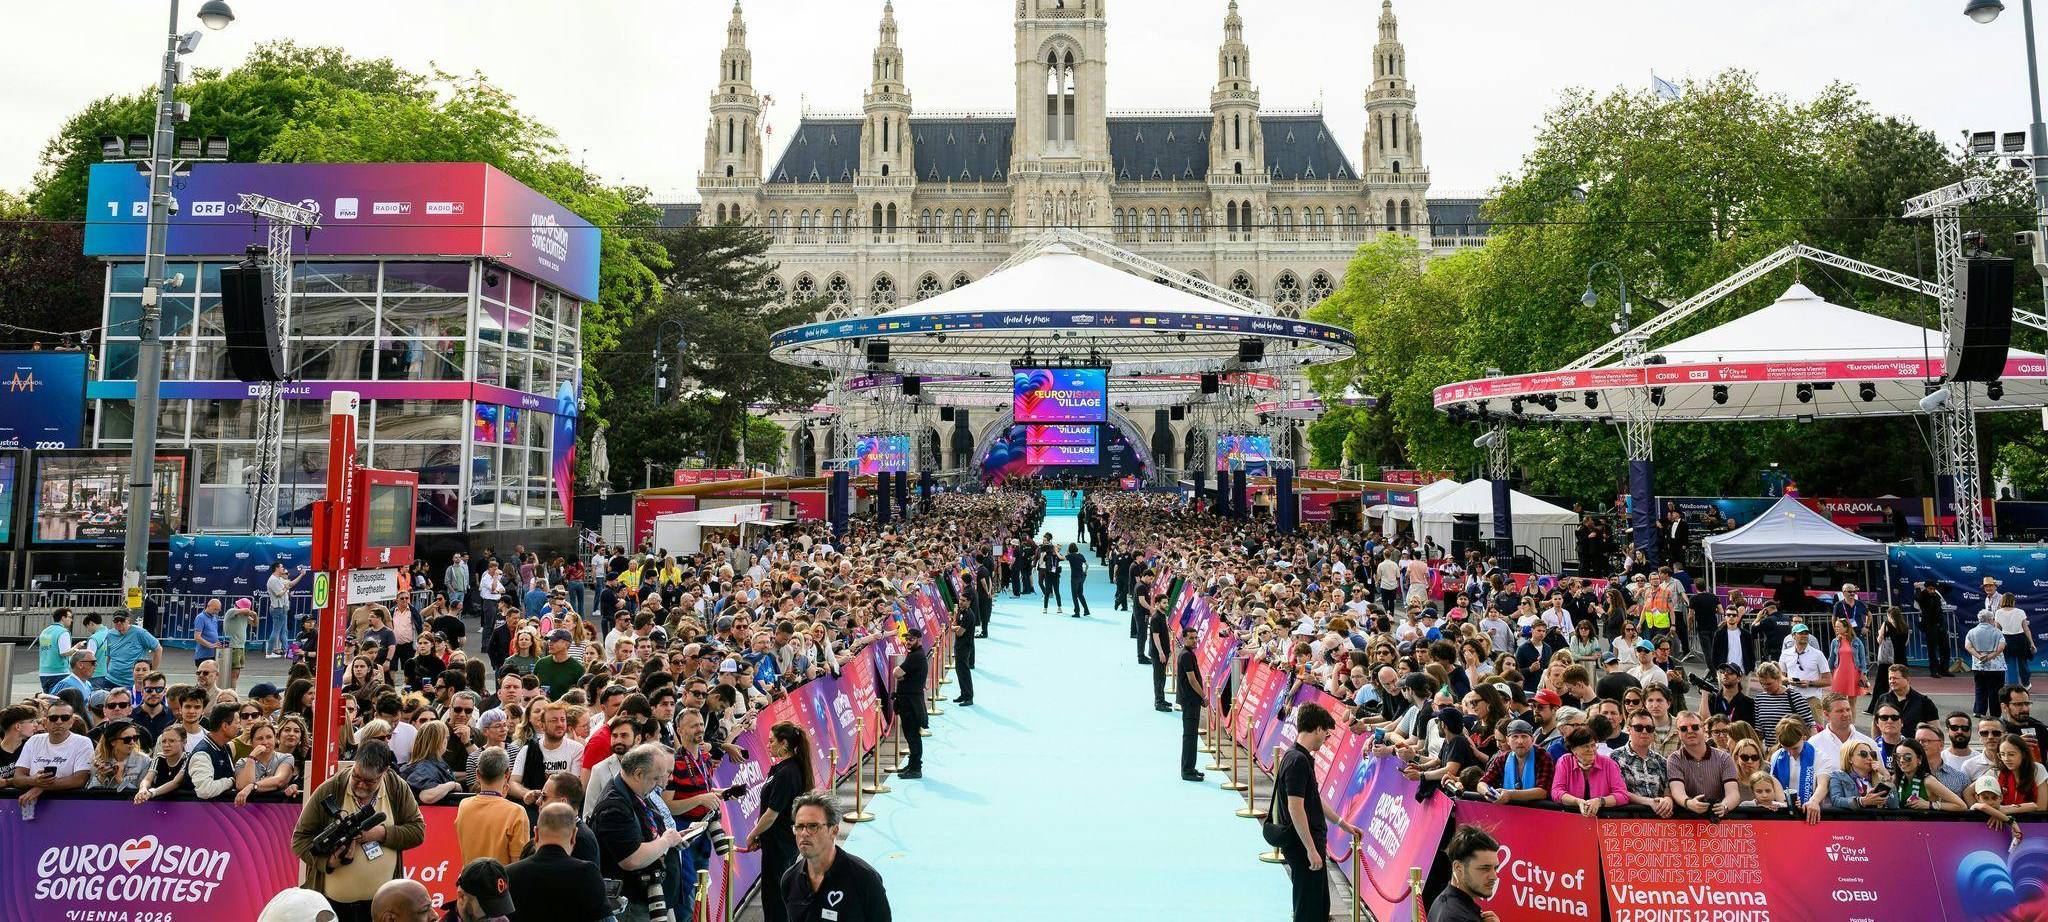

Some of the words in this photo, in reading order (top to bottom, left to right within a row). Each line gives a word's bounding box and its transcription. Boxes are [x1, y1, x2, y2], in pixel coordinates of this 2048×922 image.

[194, 204, 222, 213] ORF
[1034, 390, 1100, 400] EUROVISION
[356, 585, 386, 596] Burgtheater
[1602, 823, 1618, 837] 12
[1620, 823, 1677, 837] POINTS
[1678, 823, 1694, 837] 12
[1697, 823, 1754, 837] POINTS
[1604, 838, 1620, 852] 12
[1623, 838, 1679, 852] POINTS
[1681, 838, 1696, 852] 12
[1700, 838, 1756, 852] POINTS
[1841, 847, 1855, 856] City
[1607, 854, 1622, 868] 12
[1626, 854, 1682, 868] POINTS
[1684, 854, 1699, 868] 12
[1703, 854, 1759, 868] POINTS
[421, 860, 447, 882] of
[1511, 859, 1558, 891] City
[1560, 869, 1585, 890] of
[1609, 869, 1624, 883] 12
[1628, 869, 1684, 883] POINTS
[1686, 869, 1702, 883] 12
[1705, 869, 1762, 883] POINTS
[34, 876, 103, 900] SONG
[107, 875, 220, 902] CONTEST
[1611, 884, 1689, 905] Vienna
[1689, 885, 1767, 905] Vienna
[1512, 884, 1588, 918] Vienna
[66, 910, 128, 922] VIENNA
[135, 912, 172, 922] 2026
[1616, 909, 1631, 922] 12
[1634, 909, 1691, 922] POINTS
[1694, 909, 1709, 922] 12
[1713, 909, 1770, 922] POINTS
